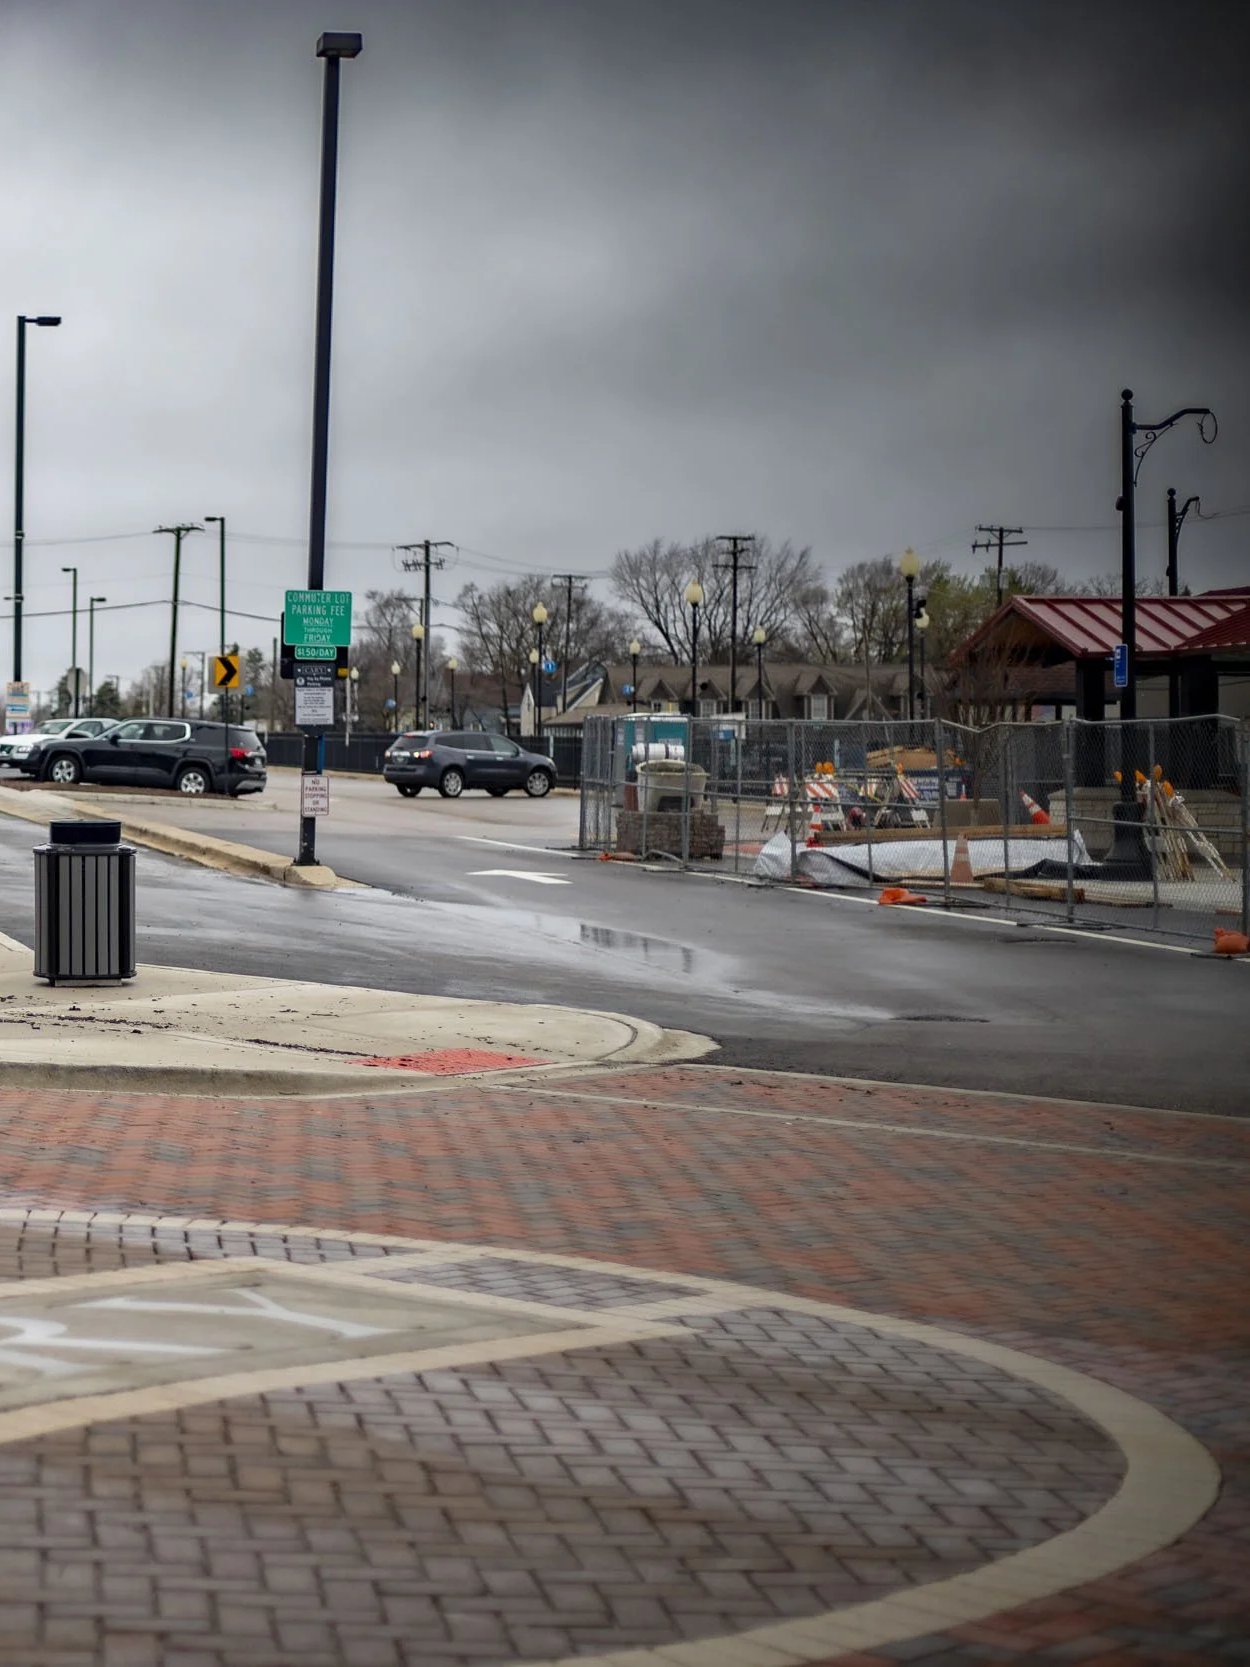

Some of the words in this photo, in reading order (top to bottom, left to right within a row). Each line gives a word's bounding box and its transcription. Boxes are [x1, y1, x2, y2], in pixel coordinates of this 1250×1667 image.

[287, 591, 330, 604] COMMUTER
[334, 594, 350, 604] LOT
[291, 604, 327, 616] PARKING
[330, 605, 345, 616] FEE
[303, 617, 333, 627] MONDAY
[304, 634, 331, 642] FRIDAY
